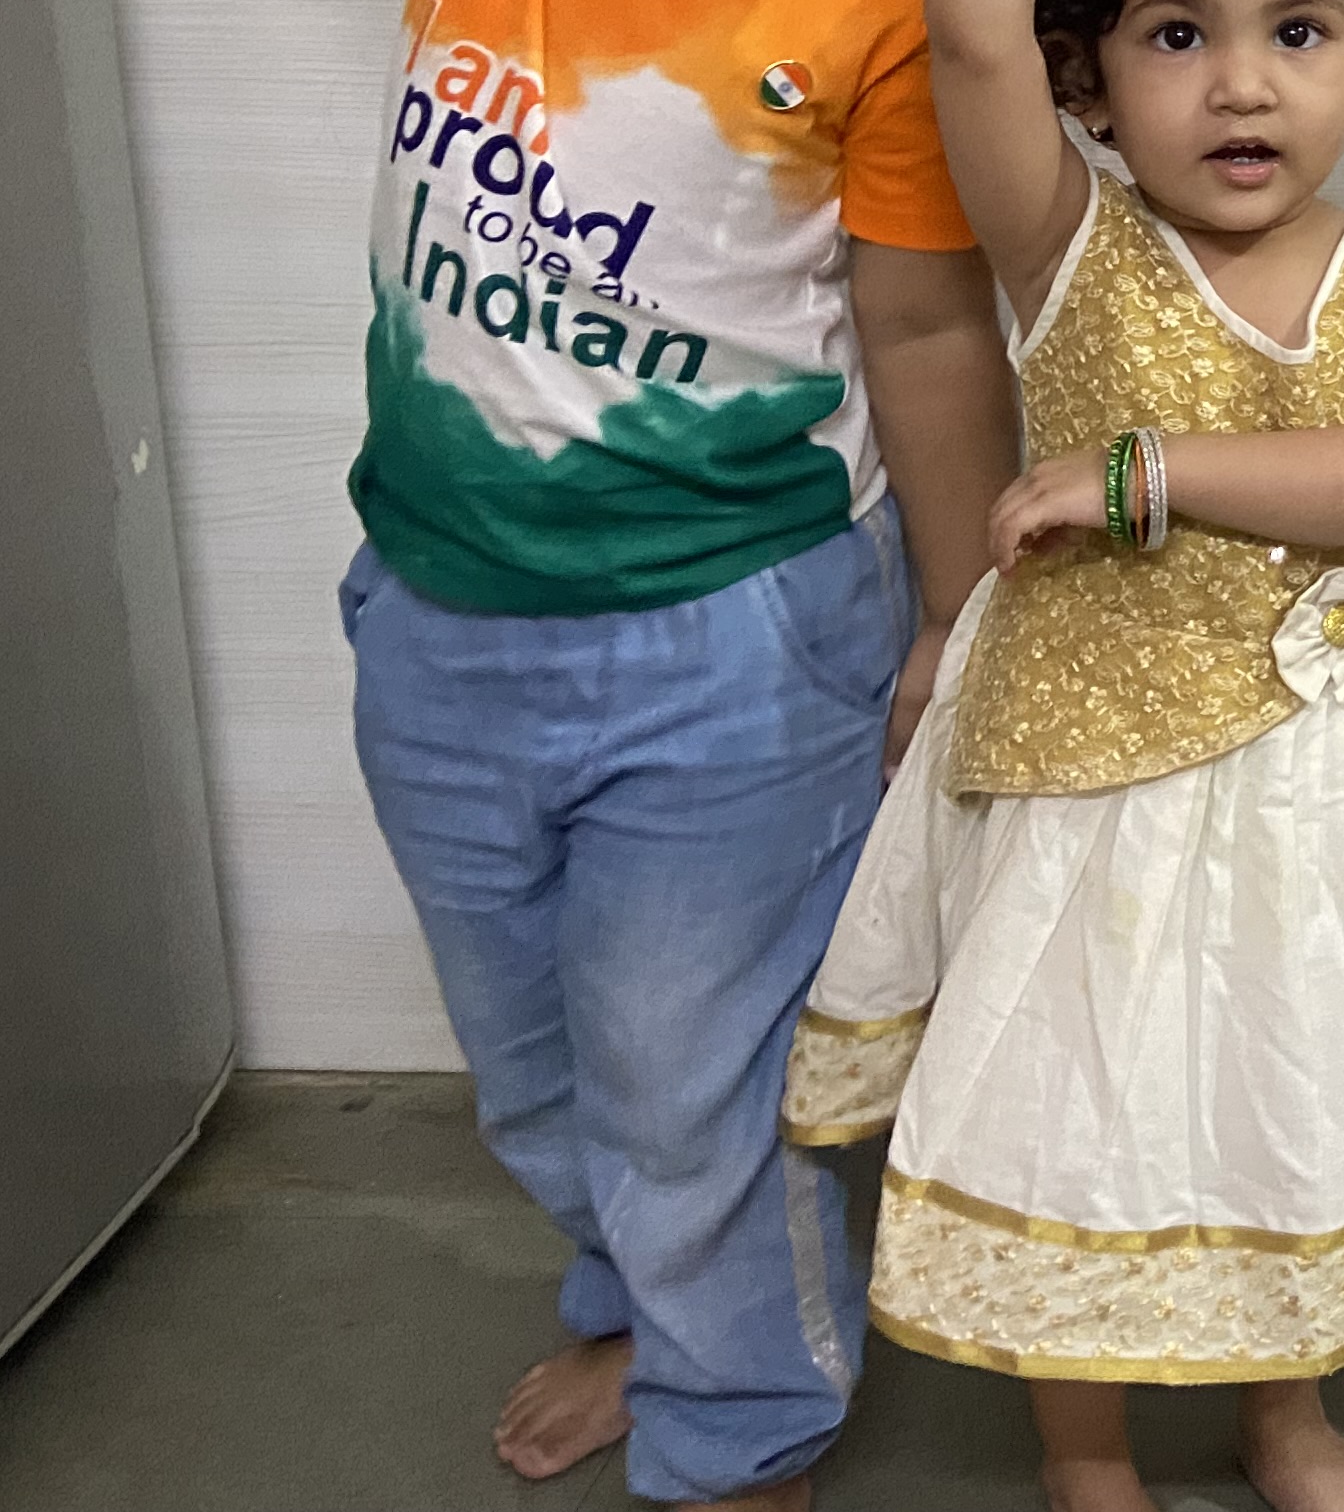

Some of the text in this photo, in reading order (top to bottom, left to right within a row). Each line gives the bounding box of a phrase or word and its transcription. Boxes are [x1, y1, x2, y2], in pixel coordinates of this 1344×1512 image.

[390, 85, 656, 279] proud
[464, 195, 660, 310] to be a
[402, 181, 708, 384] Indian
